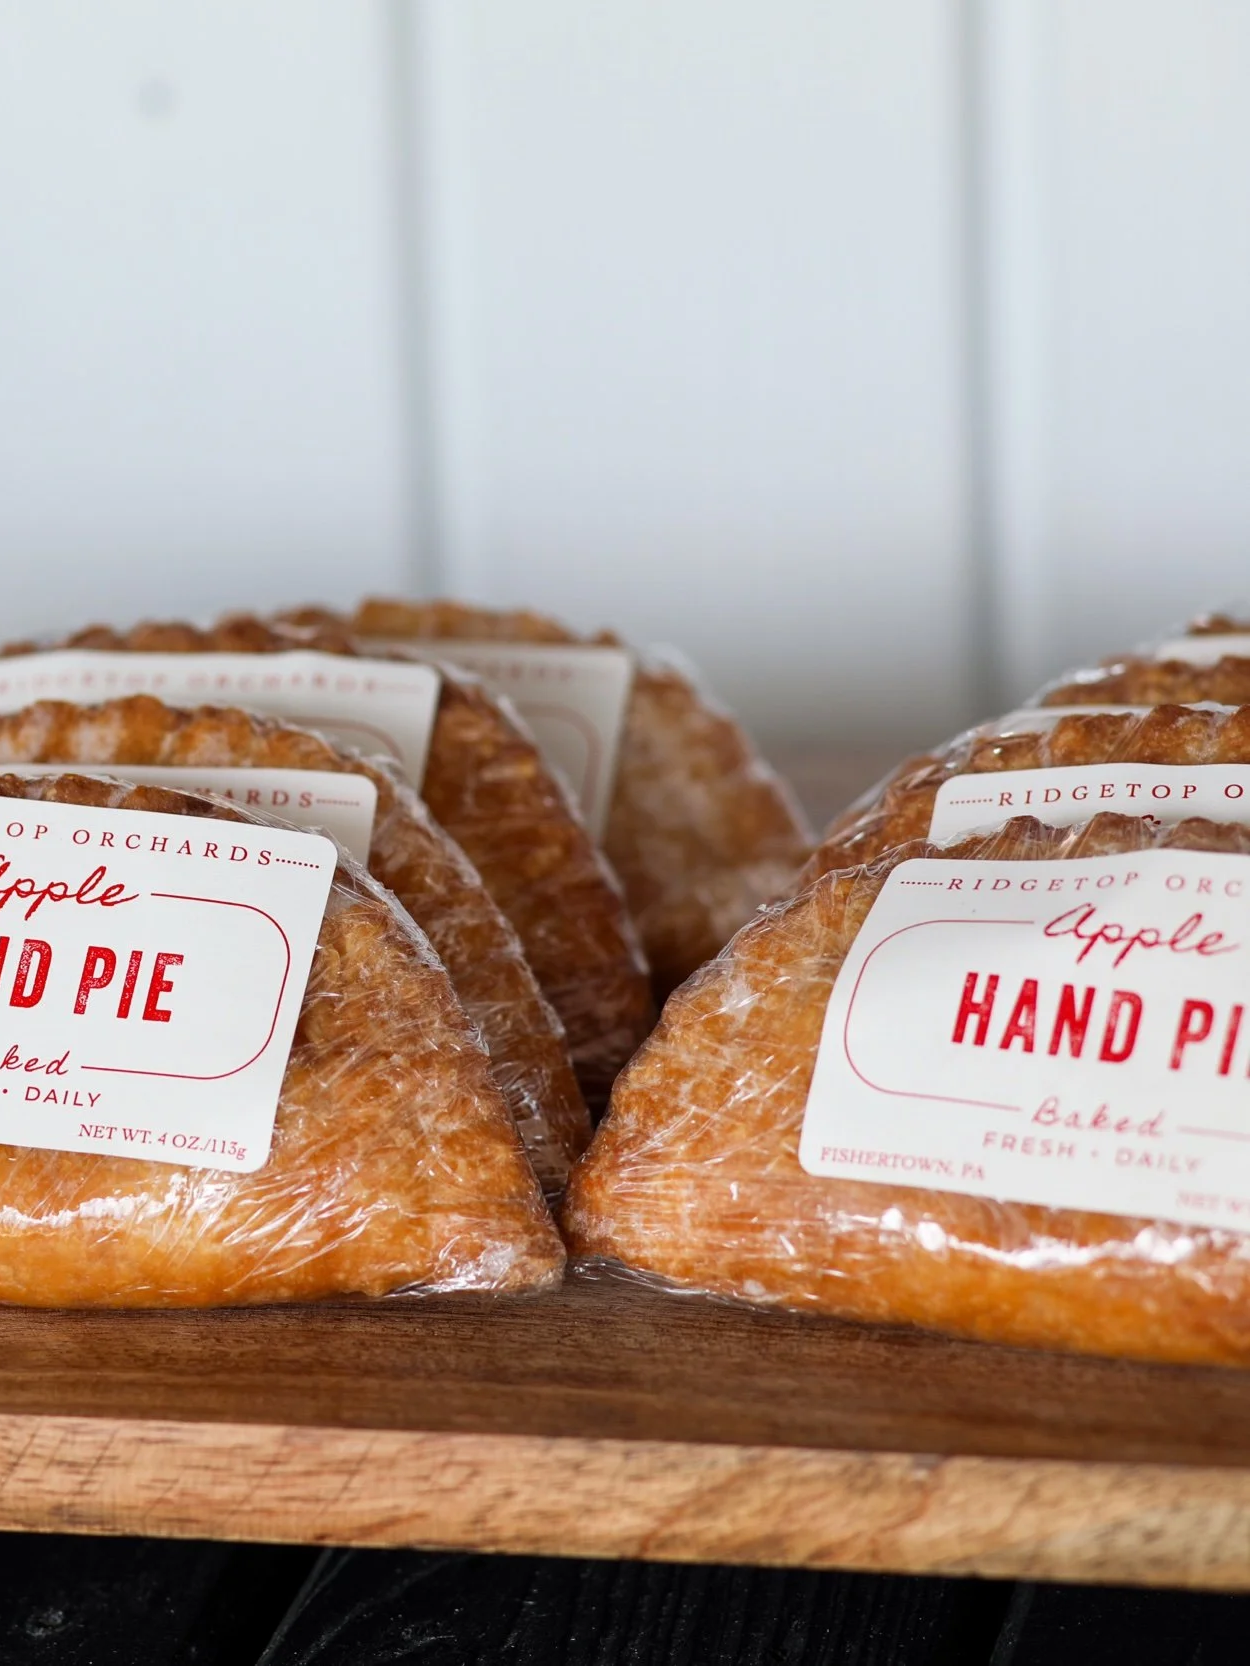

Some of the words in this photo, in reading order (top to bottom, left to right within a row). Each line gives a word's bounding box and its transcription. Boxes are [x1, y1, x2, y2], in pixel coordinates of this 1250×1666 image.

[999, 784, 1196, 806] RIDGETOP
[73, 827, 273, 868] ORCHARDS
[946, 872, 1138, 891] RIDGETOP
[1043, 902, 1237, 968] Apple
[73, 946, 184, 1022] PIE
[951, 972, 1143, 1063] HAND
[1170, 999, 1250, 1078] PI
[25, 1086, 101, 1107] DAILY
[1030, 1097, 1164, 1138] Baked
[78, 1124, 117, 1139] NET
[122, 1128, 151, 1143] WT.
[158, 1133, 167, 1145] 4
[172, 1134, 246, 1160] OZ./113g
[982, 1131, 1075, 1158] FRESH
[1115, 1147, 1201, 1173] DAILY
[962, 1163, 985, 1180] PA
